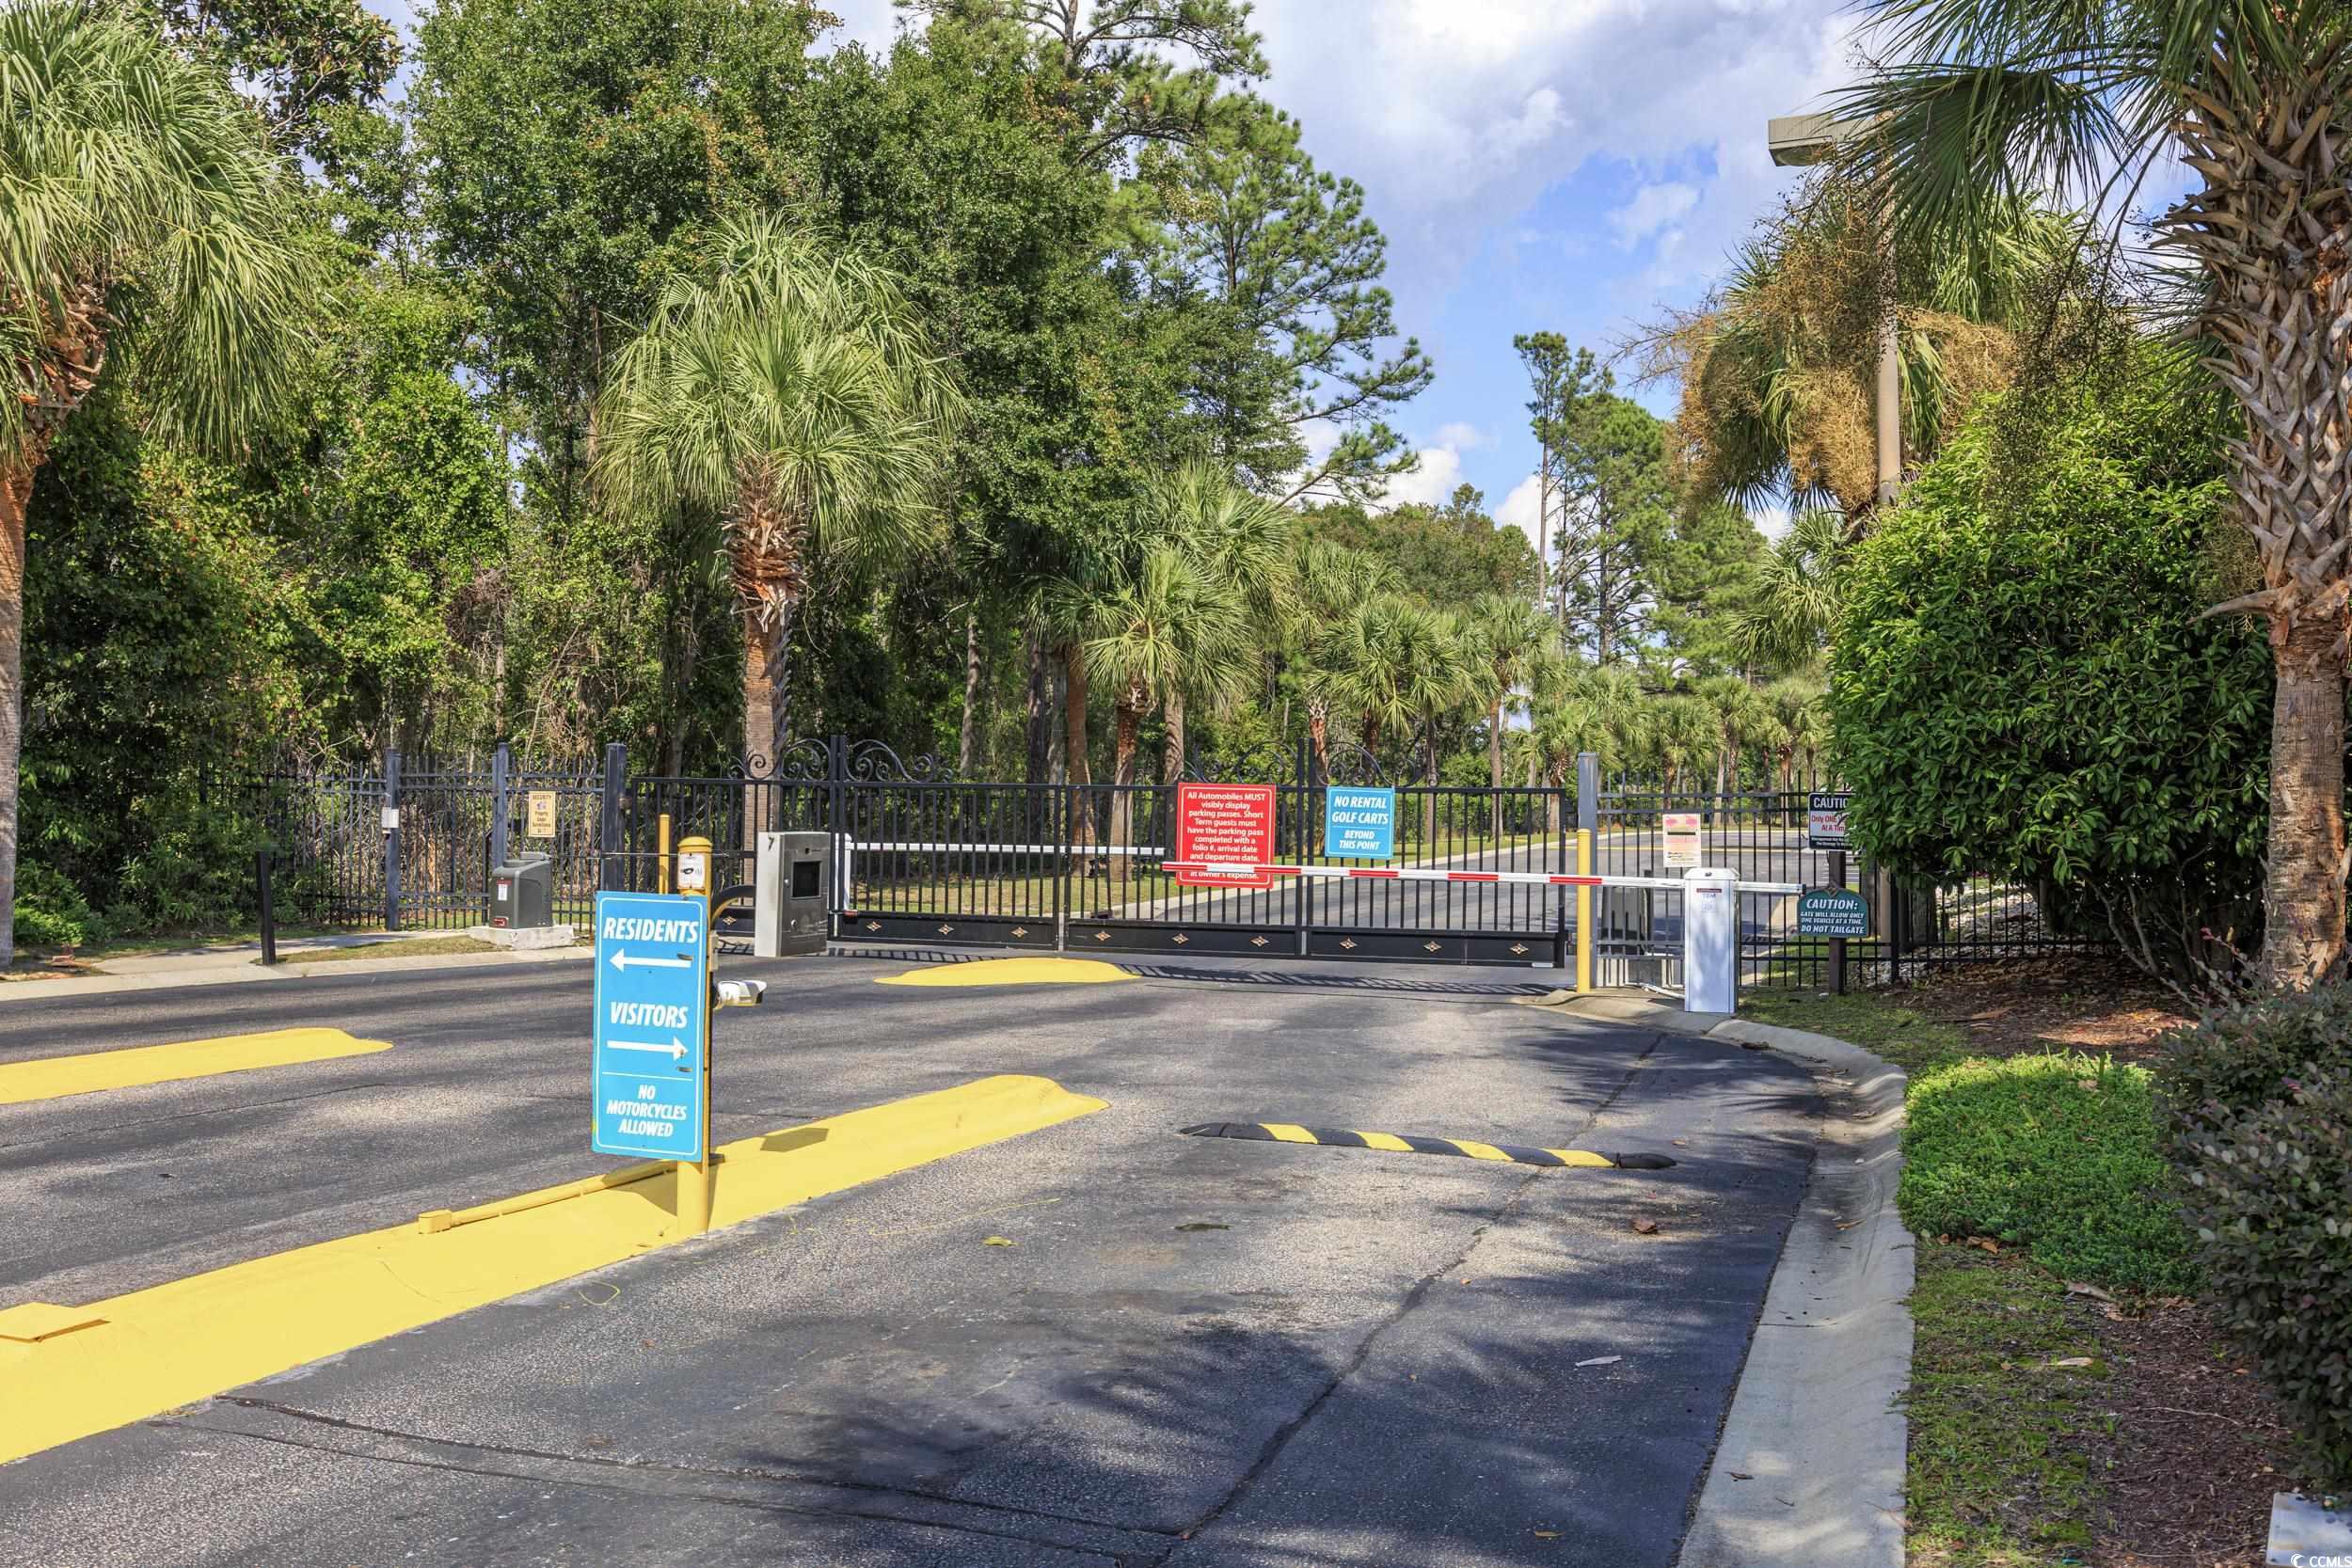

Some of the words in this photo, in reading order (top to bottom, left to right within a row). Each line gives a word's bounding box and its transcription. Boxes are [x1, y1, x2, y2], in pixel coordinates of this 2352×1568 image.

[1334, 796, 1349, 807] NO
[1350, 797, 1386, 808] RENTAL
[1814, 797, 1849, 808] CAUTIO
[1332, 812, 1357, 823] GOLF
[1359, 813, 1389, 824] CARTS
[1344, 830, 1375, 839] BEYOND
[1340, 840, 1356, 849] THIS
[1357, 841, 1380, 850] POINT
[1807, 899, 1858, 910] CAUTION:
[603, 917, 699, 943] RESIDENTS
[610, 1001, 688, 1028] VISITORS
[638, 1084, 656, 1100] NO
[606, 1100, 687, 1120] MOTORCYCLES
[618, 1118, 673, 1137] ALLOWED
